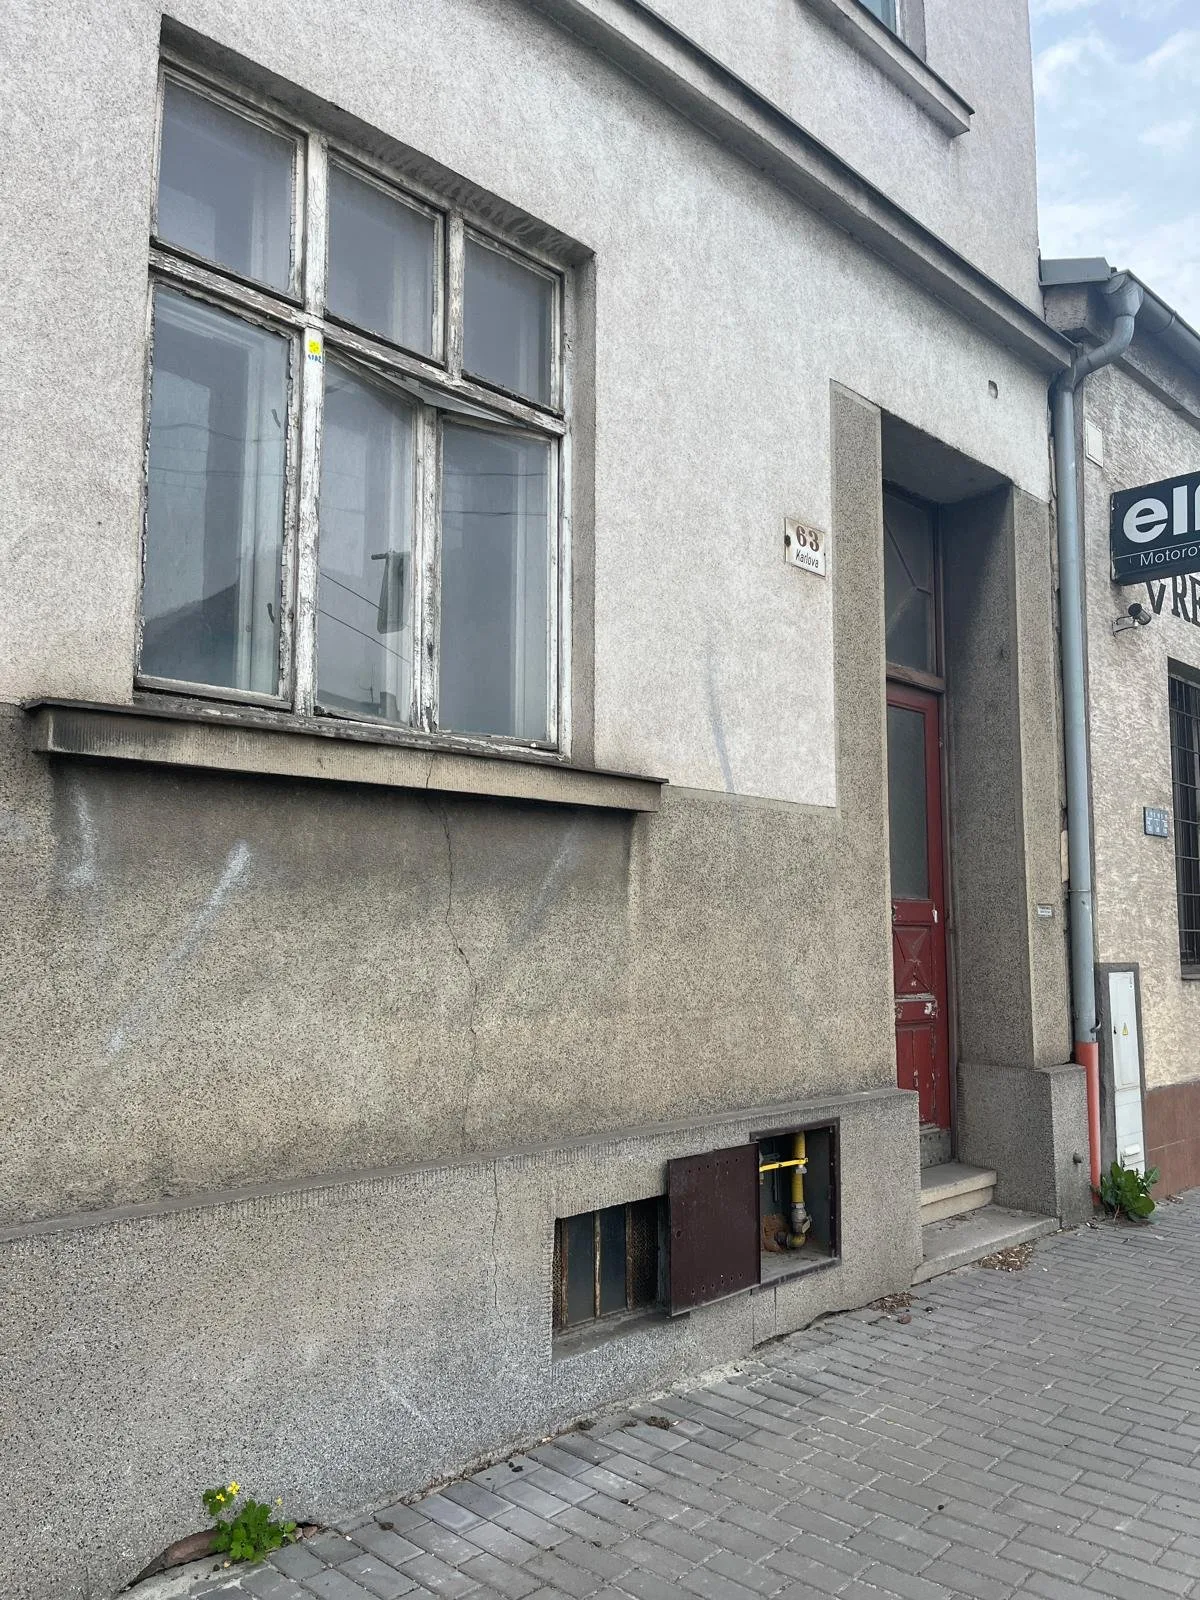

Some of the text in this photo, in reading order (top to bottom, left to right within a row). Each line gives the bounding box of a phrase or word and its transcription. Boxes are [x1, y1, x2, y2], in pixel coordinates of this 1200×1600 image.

[1123, 484, 1200, 543] el
[796, 525, 820, 552] 63
[795, 548, 819, 569] Karlova
[1140, 545, 1200, 566] Motoro
